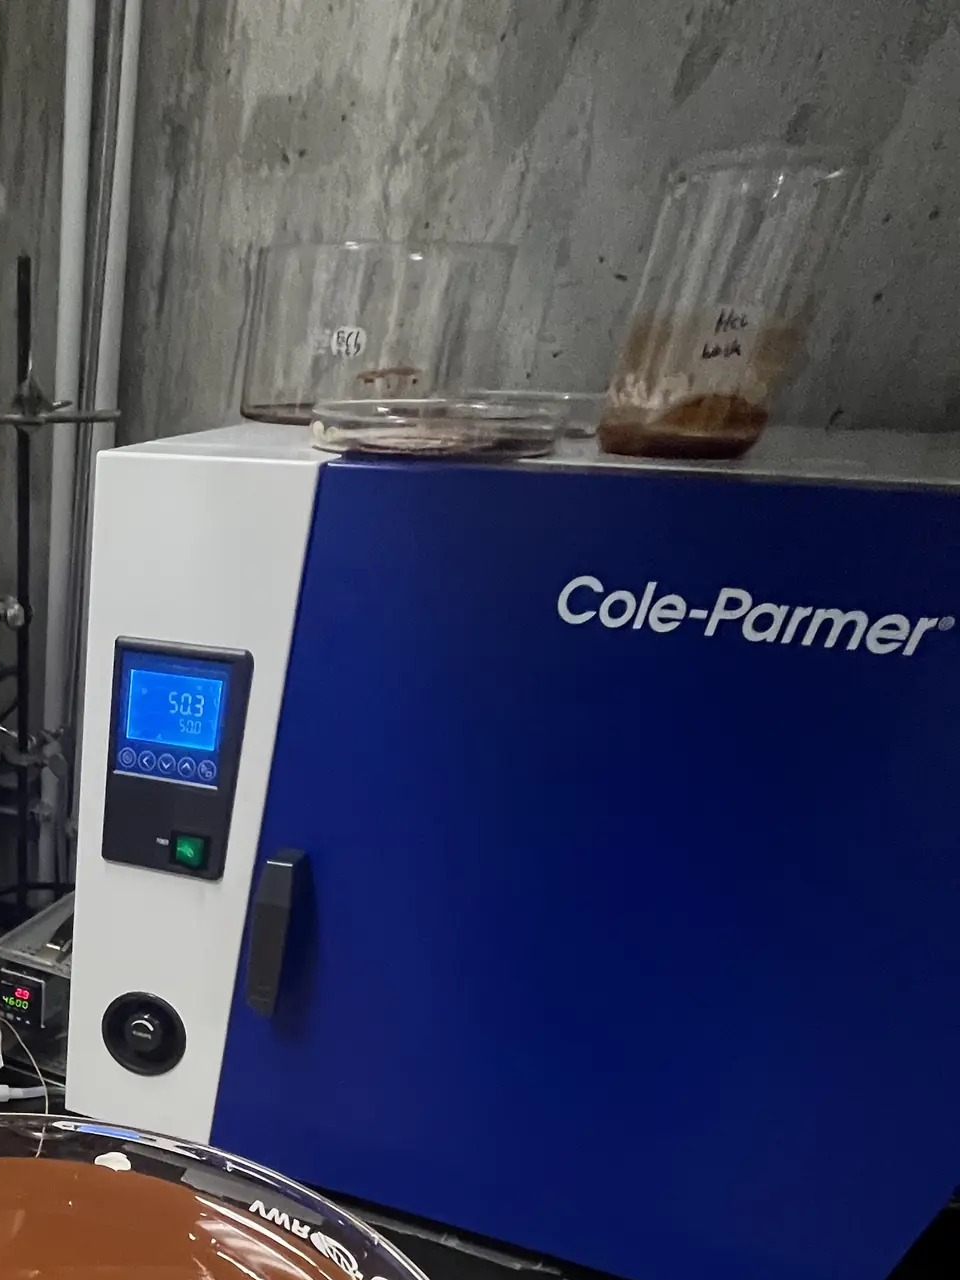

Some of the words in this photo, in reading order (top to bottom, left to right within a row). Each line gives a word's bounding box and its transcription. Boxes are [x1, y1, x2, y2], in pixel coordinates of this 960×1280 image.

[557, 575, 939, 656] Cole-Parmer
[168, 691, 205, 718] 50.3
[179, 718, 202, 735] 50.0
[2, 995, 29, 1010] 4600
